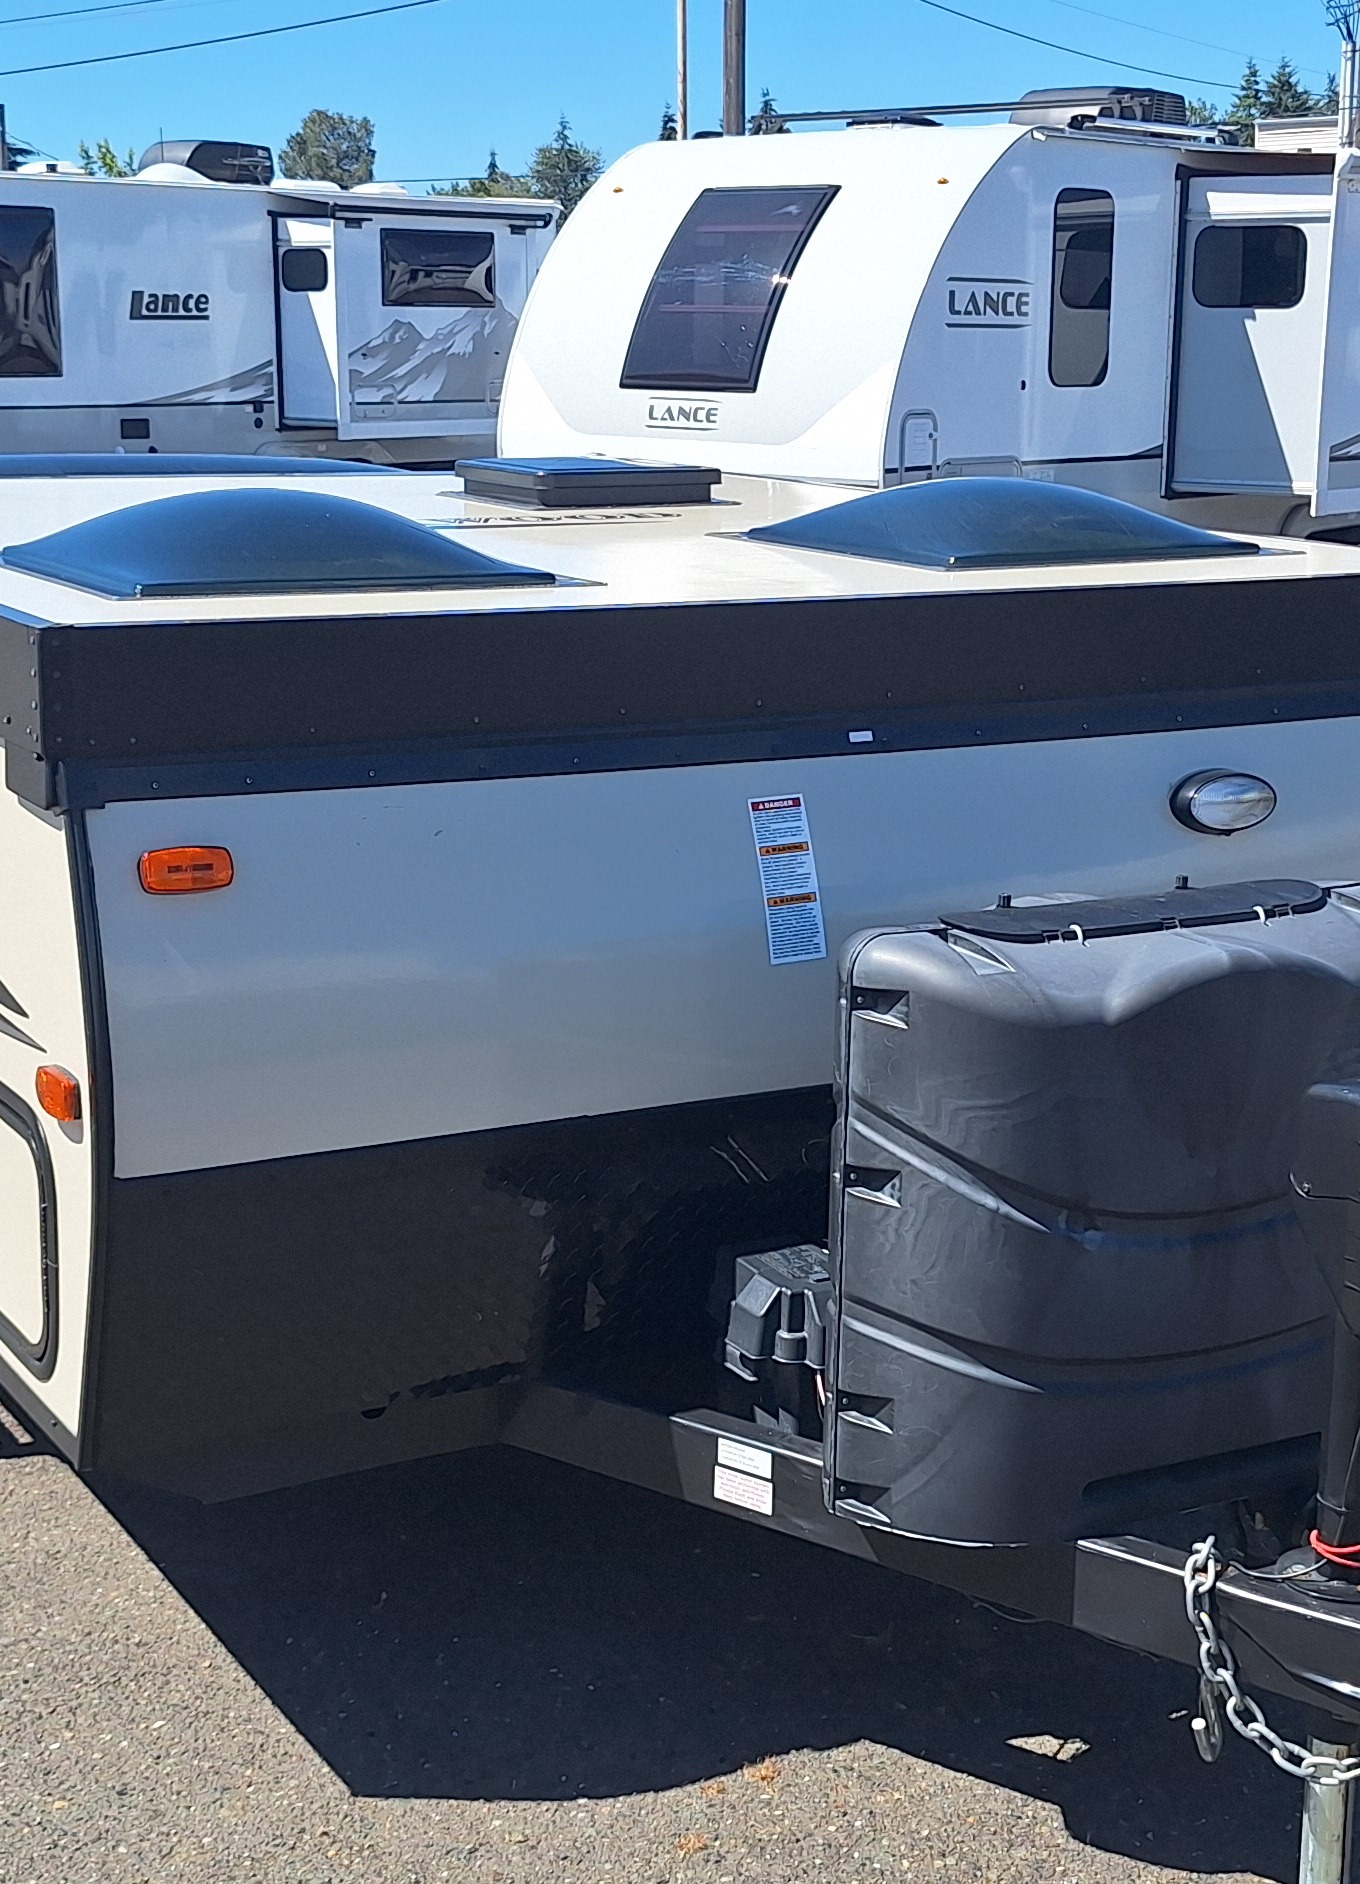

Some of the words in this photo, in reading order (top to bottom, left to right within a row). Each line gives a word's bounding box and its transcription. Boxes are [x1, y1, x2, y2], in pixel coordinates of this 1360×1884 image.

[129, 291, 210, 321] Lance
[948, 289, 1030, 317] LANCE
[648, 404, 719, 423] LANCE
